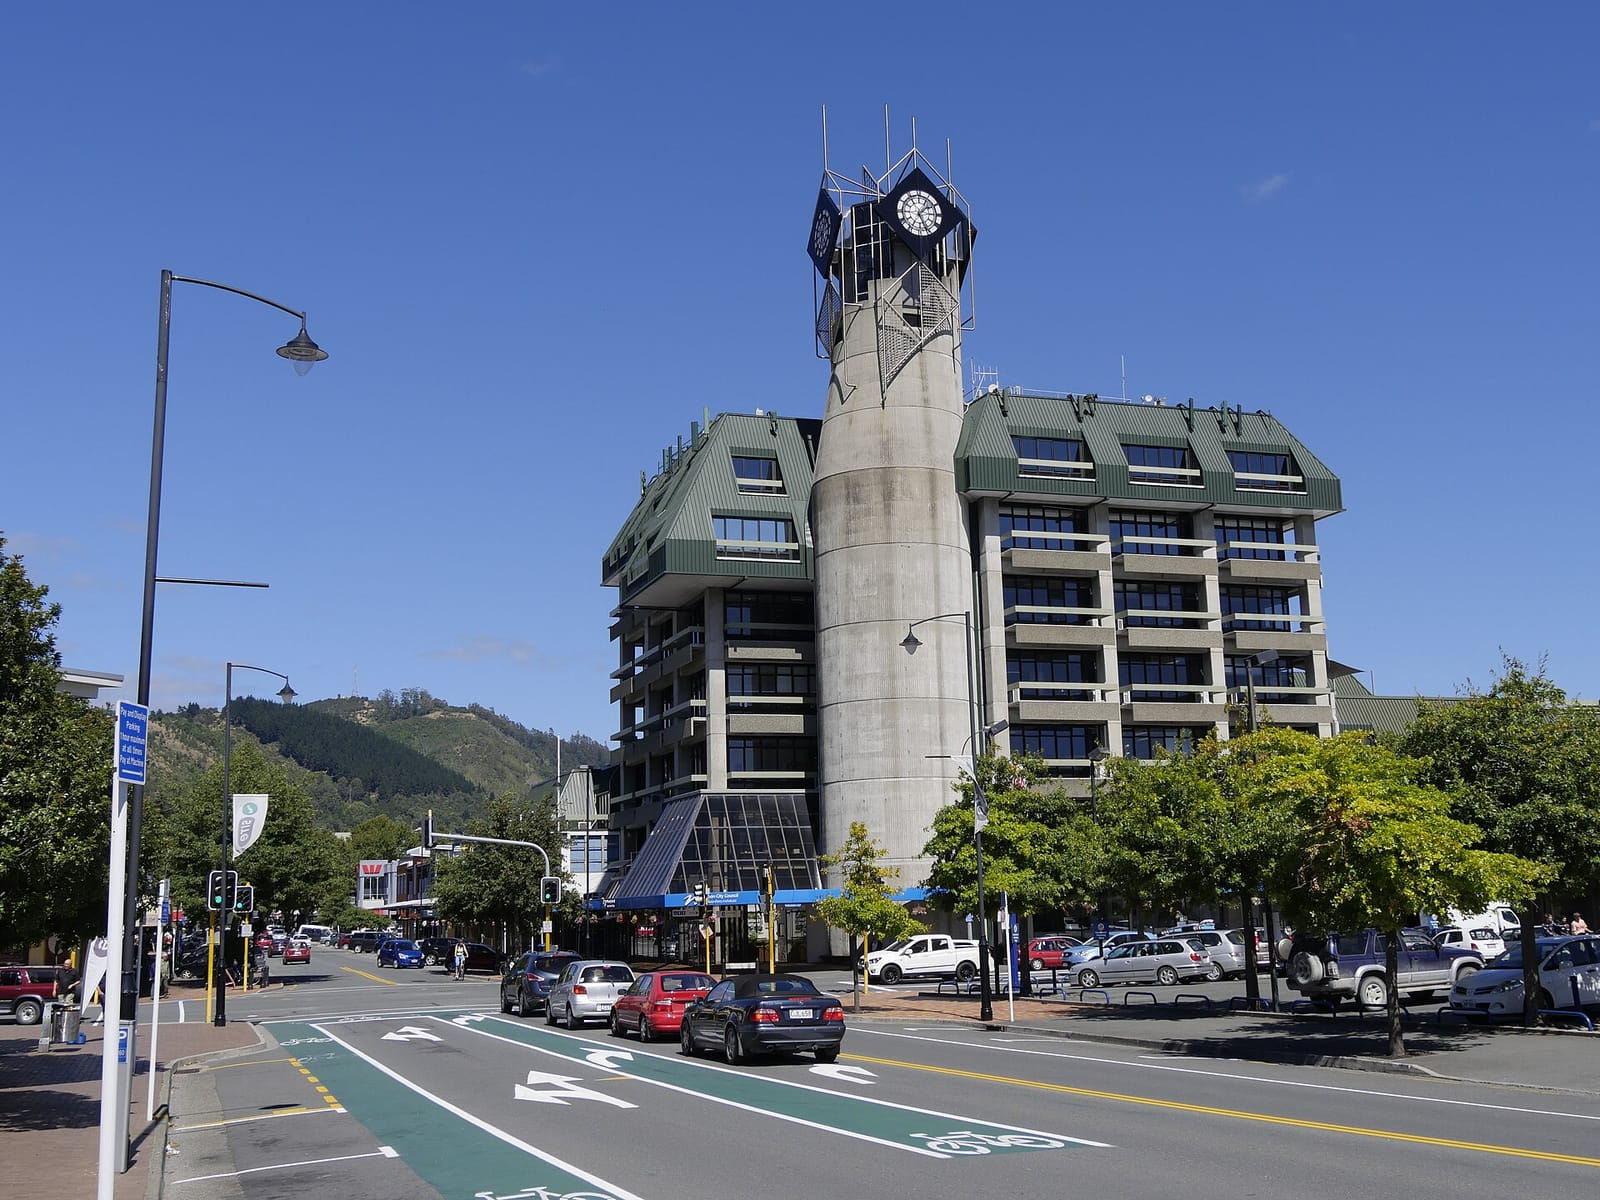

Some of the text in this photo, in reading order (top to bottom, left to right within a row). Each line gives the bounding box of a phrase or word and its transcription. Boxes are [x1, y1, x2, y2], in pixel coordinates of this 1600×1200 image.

[127, 709, 135, 718] and
[126, 720, 140, 733] Parking
[132, 746, 143, 756] times
